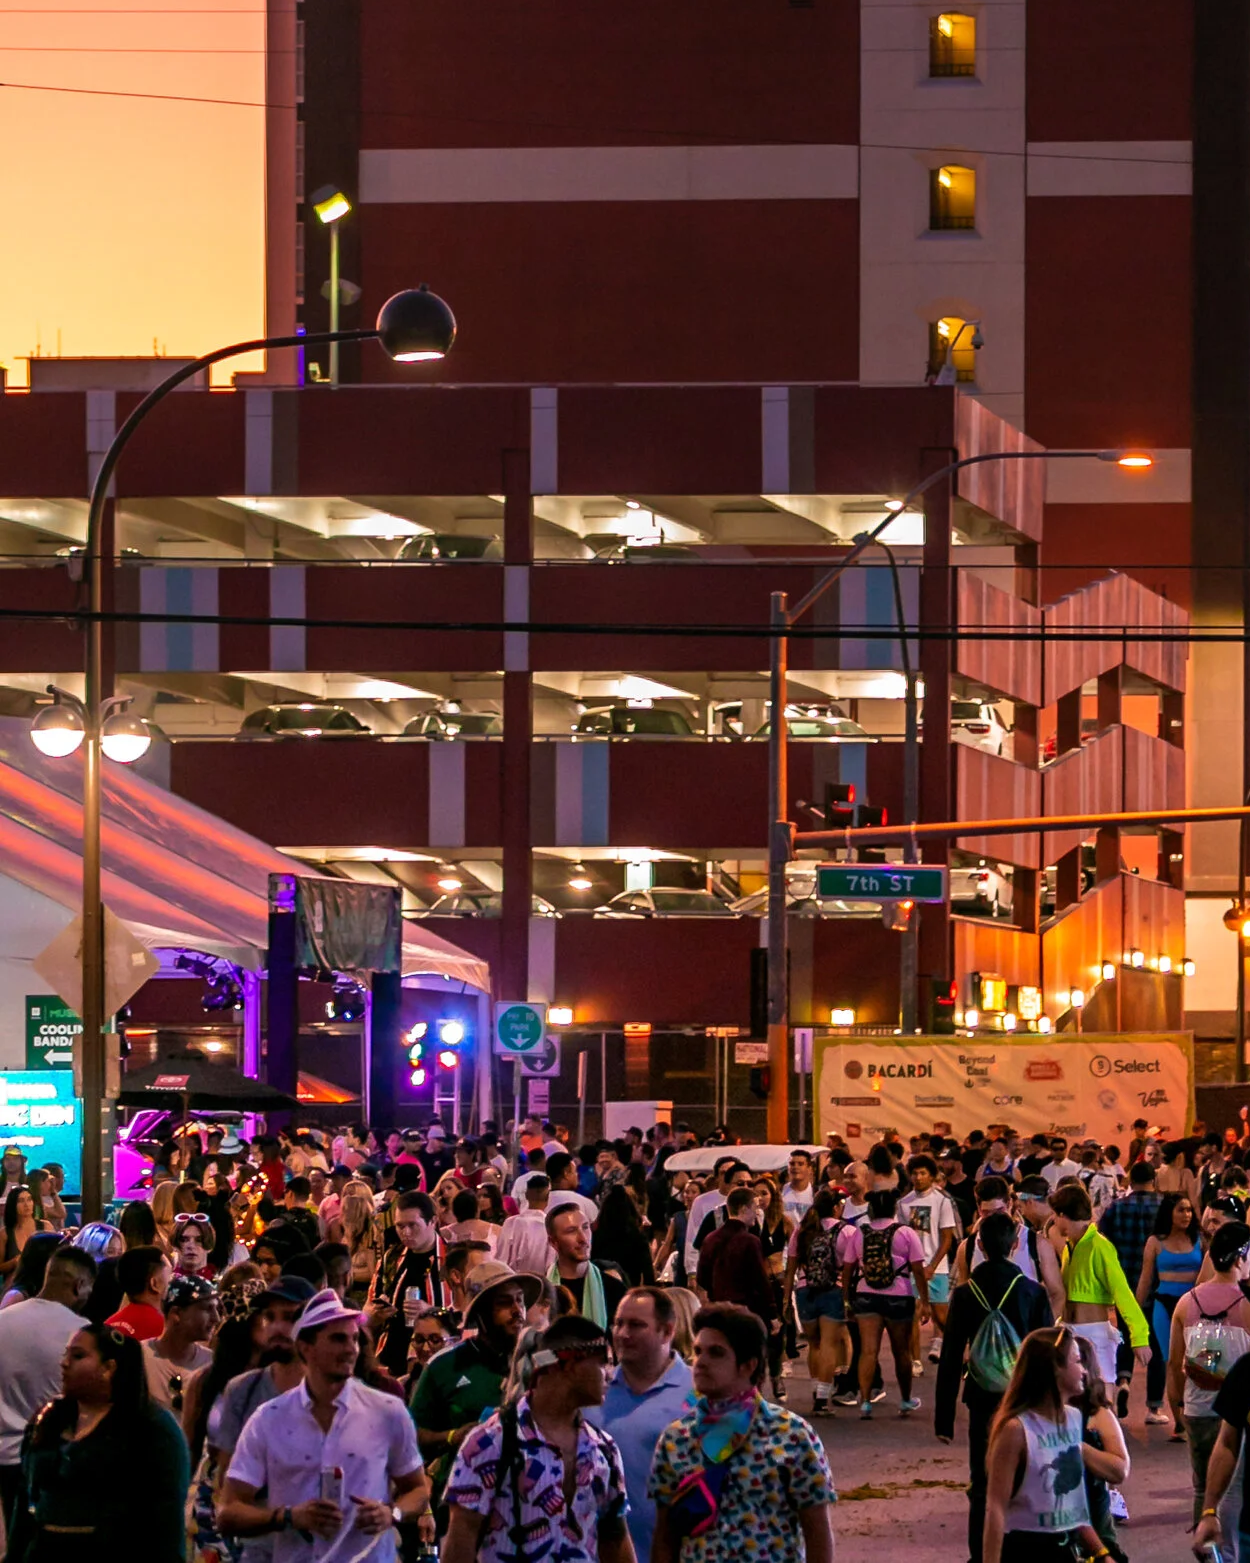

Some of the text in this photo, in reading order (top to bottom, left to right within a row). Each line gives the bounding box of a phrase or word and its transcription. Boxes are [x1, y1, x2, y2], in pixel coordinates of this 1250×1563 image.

[846, 875, 915, 892] 7th ST
[39, 1024, 84, 1035] COOLIN
[867, 1059, 934, 1078] BACARDÍ
[1113, 1059, 1161, 1074] Select
[992, 1094, 1023, 1107] core
